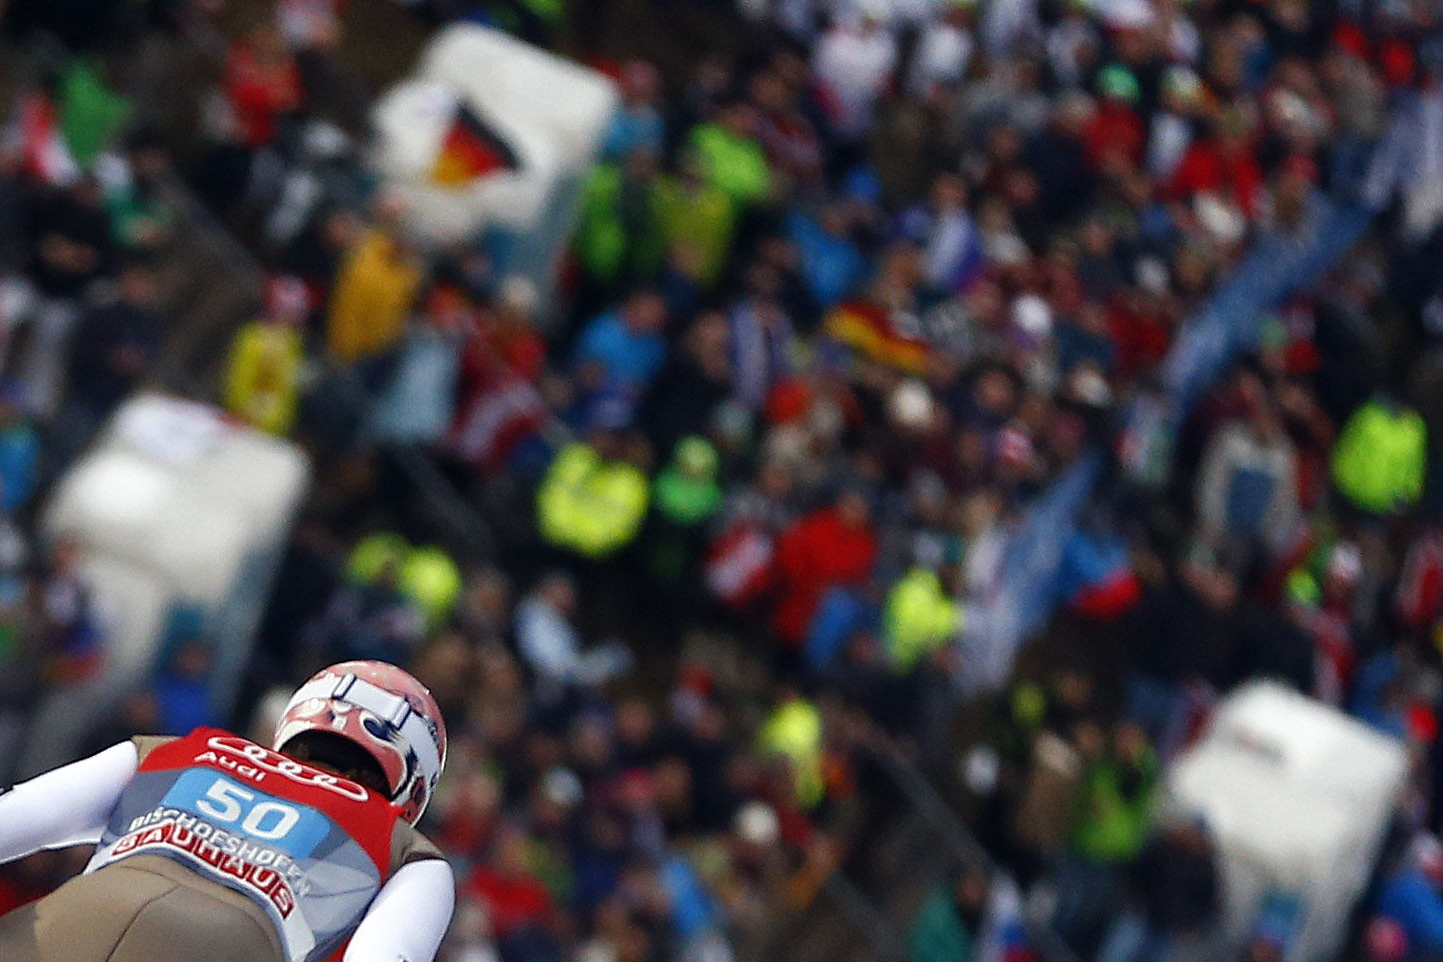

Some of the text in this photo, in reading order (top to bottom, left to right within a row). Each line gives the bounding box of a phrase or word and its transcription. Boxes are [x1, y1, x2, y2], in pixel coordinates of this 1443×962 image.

[194, 751, 267, 782] Audi
[196, 778, 300, 840] 50
[114, 828, 295, 913] BAUHAUS
